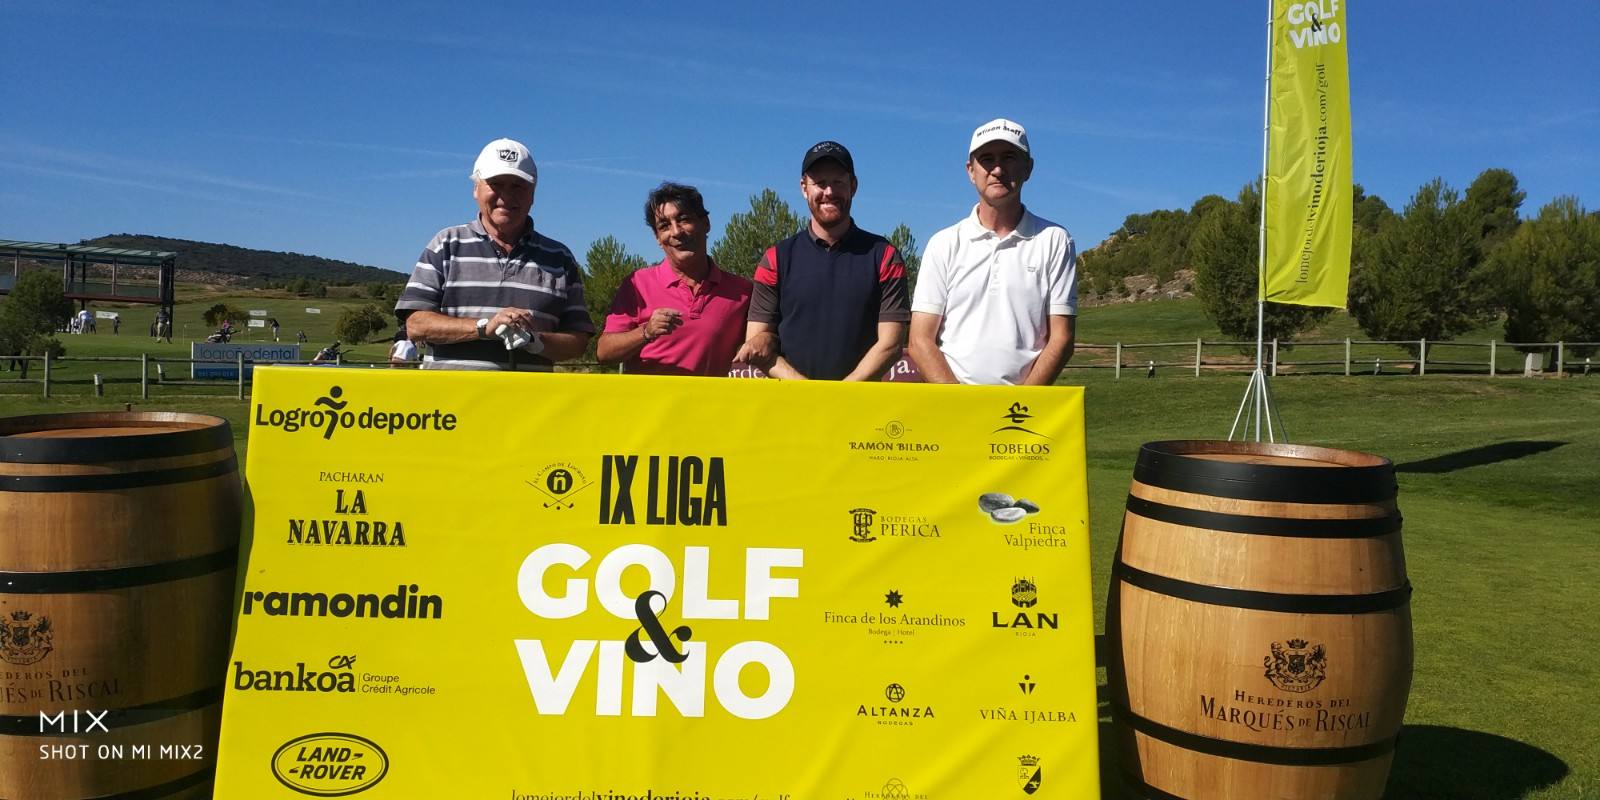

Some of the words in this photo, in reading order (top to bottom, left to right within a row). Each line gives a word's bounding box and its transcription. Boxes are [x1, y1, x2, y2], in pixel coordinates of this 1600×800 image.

[1287, 0, 1339, 24] GOLF
[1311, 13, 1323, 32] &
[1289, 22, 1341, 48] VINO
[358, 407, 457, 435] deporte
[849, 440, 894, 451] RAMÓN
[896, 443, 940, 452] BILBAO
[988, 443, 1050, 455] TOBELOS
[319, 471, 384, 484] PACHARAN
[553, 471, 567, 491] ñ
[599, 455, 639, 525] IX
[646, 455, 728, 526] LIGA
[335, 489, 368, 515] LA
[880, 515, 927, 523] BODEGAS
[286, 519, 408, 548] NAVARRA
[880, 523, 942, 538] PERICA
[1028, 522, 1067, 536] Finca
[1004, 534, 1067, 550] Valpiedra
[517, 543, 804, 620] GOLF
[243, 583, 443, 619] ramondin
[624, 589, 693, 664] &
[824, 611, 857, 624] Finca
[860, 612, 876, 625] de
[879, 612, 897, 625] los
[899, 613, 966, 627] Arandinos
[991, 611, 1059, 629] LAN
[868, 628, 892, 637] Bodega
[62, 667, 88, 678] DEL
[233, 661, 356, 693] bankoa
[362, 672, 400, 684] Groupe
[513, 639, 795, 720] VINO
[31, 689, 44, 698] DE
[49, 678, 121, 702] RISCAL
[361, 684, 392, 694] Crédit
[394, 685, 436, 696] Agricole
[1235, 689, 1322, 709] HEREDEROS
[1330, 698, 1351, 708] DEL
[857, 703, 935, 719] ALTANZA
[980, 706, 1018, 721] VIÑA
[1024, 710, 1077, 724] IJALBA
[1200, 694, 1295, 733] MARQUÉS
[1299, 717, 1312, 728] DE
[1315, 709, 1371, 732] RISCAL
